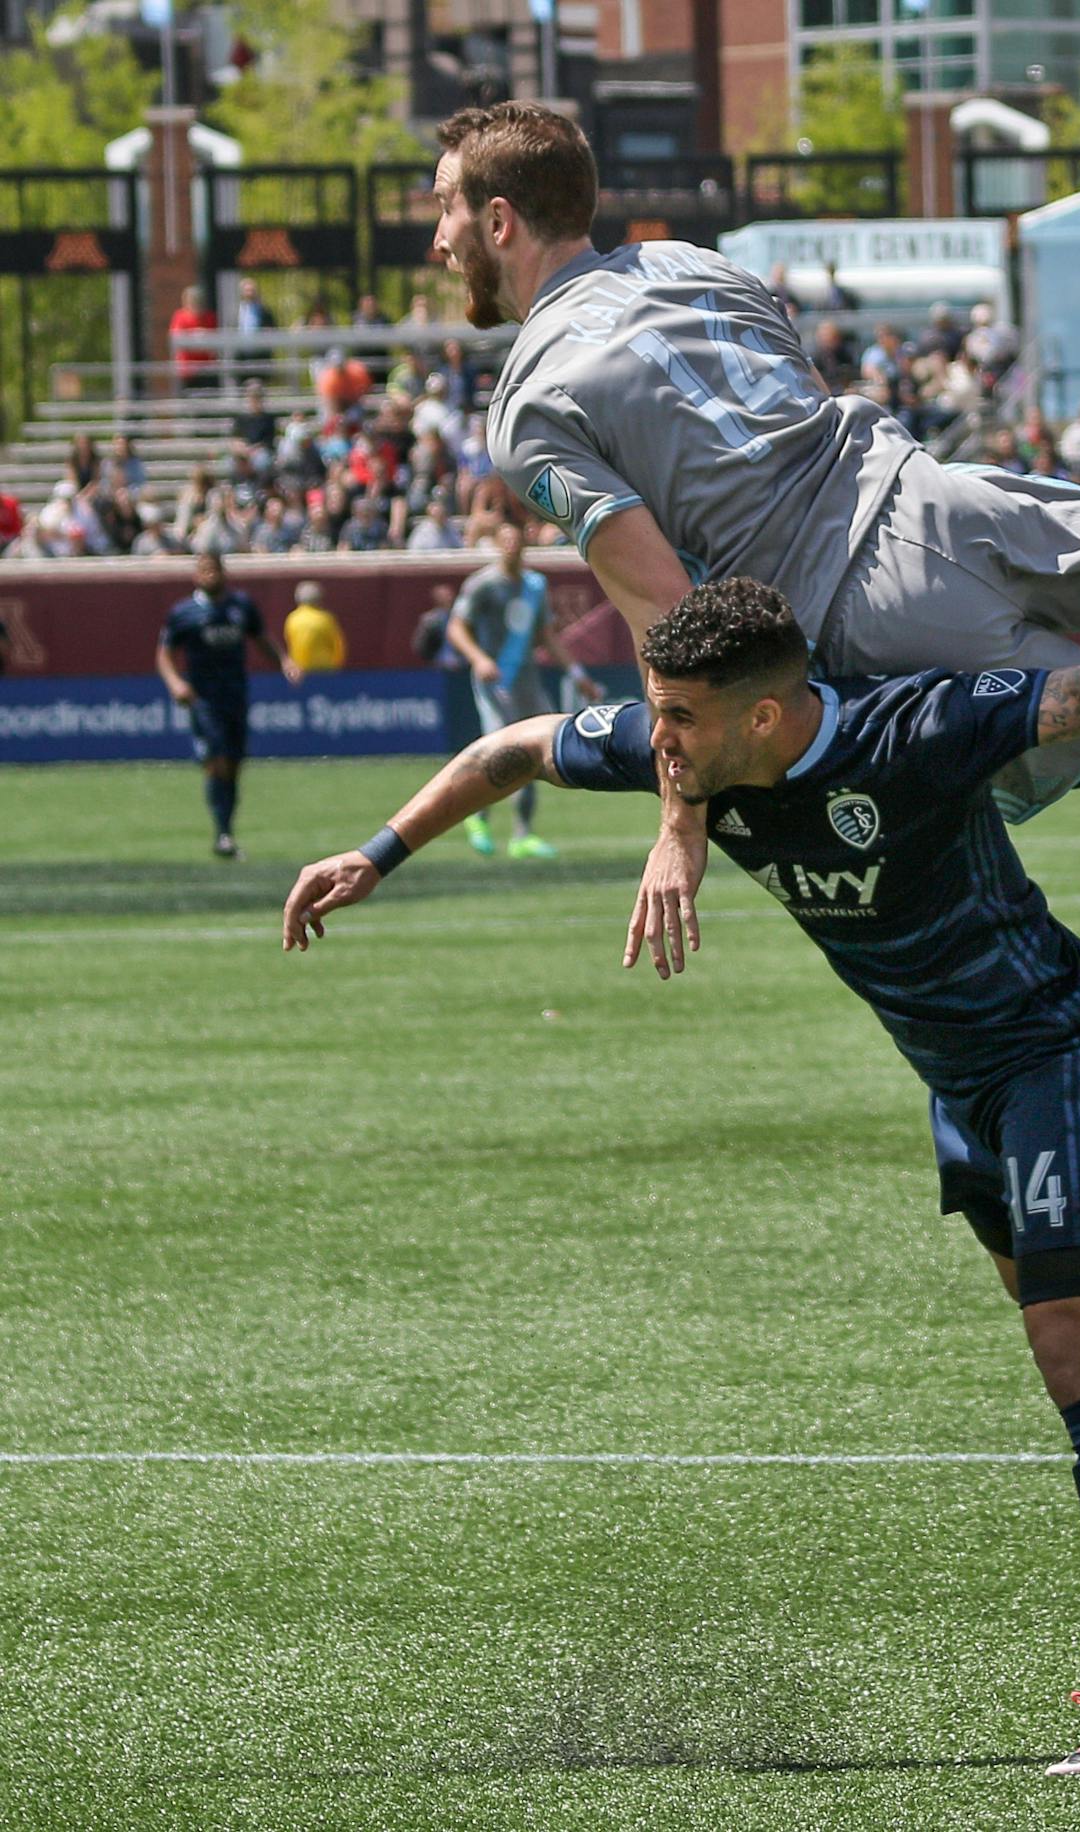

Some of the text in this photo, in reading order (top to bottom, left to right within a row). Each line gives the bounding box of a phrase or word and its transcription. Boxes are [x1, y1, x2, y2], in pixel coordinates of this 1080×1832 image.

[565, 248, 712, 345] KALLMAN
[307, 693, 438, 736] Systems
[1006, 1149, 1068, 1233] 14
